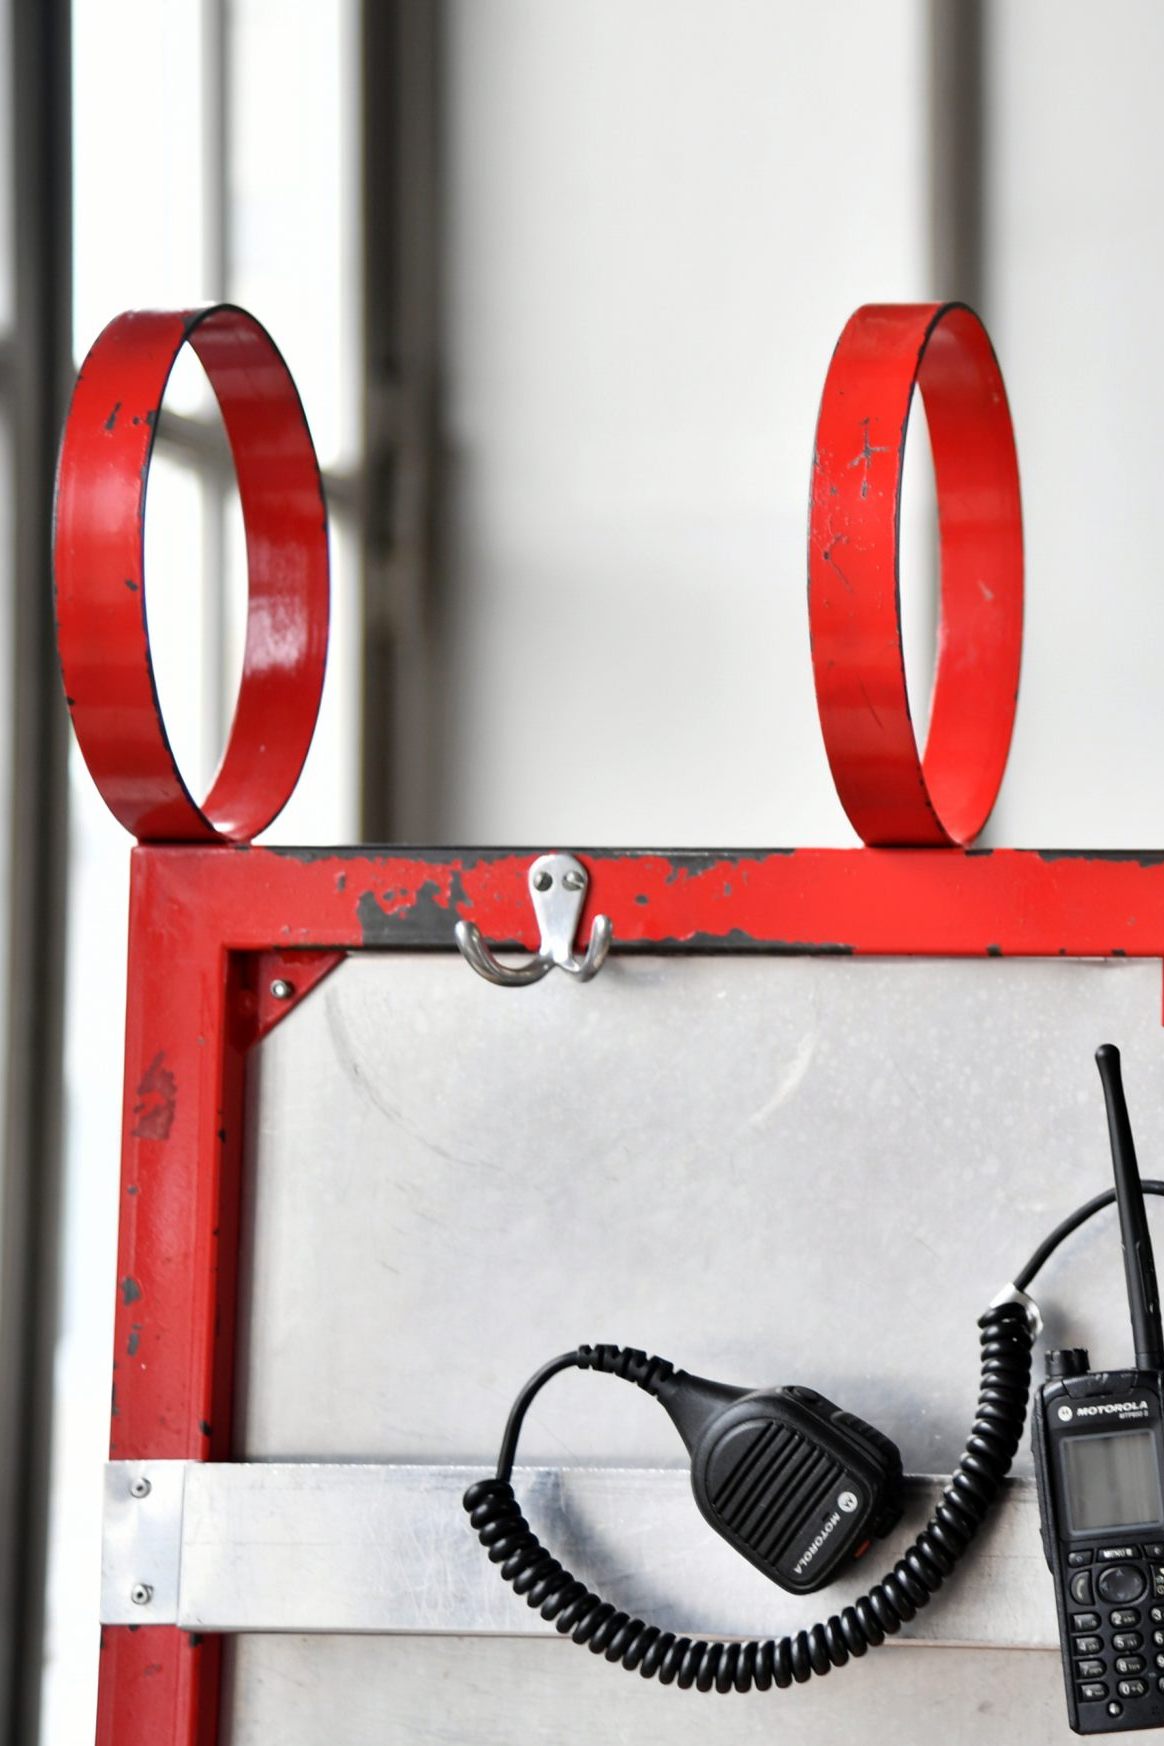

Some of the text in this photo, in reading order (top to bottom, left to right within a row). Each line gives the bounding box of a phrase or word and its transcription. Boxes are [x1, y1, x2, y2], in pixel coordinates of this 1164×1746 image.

[1077, 1401, 1148, 1416] MOTOROLA
[793, 1511, 841, 1574] MOTOROLA
[1111, 1611, 1121, 1624] 2
[1151, 1608, 1161, 1620] 3
[1115, 1635, 1124, 1648] 5
[1154, 1631, 1163, 1644] 6
[1117, 1658, 1127, 1672] 8
[1156, 1654, 1164, 1668] 9
